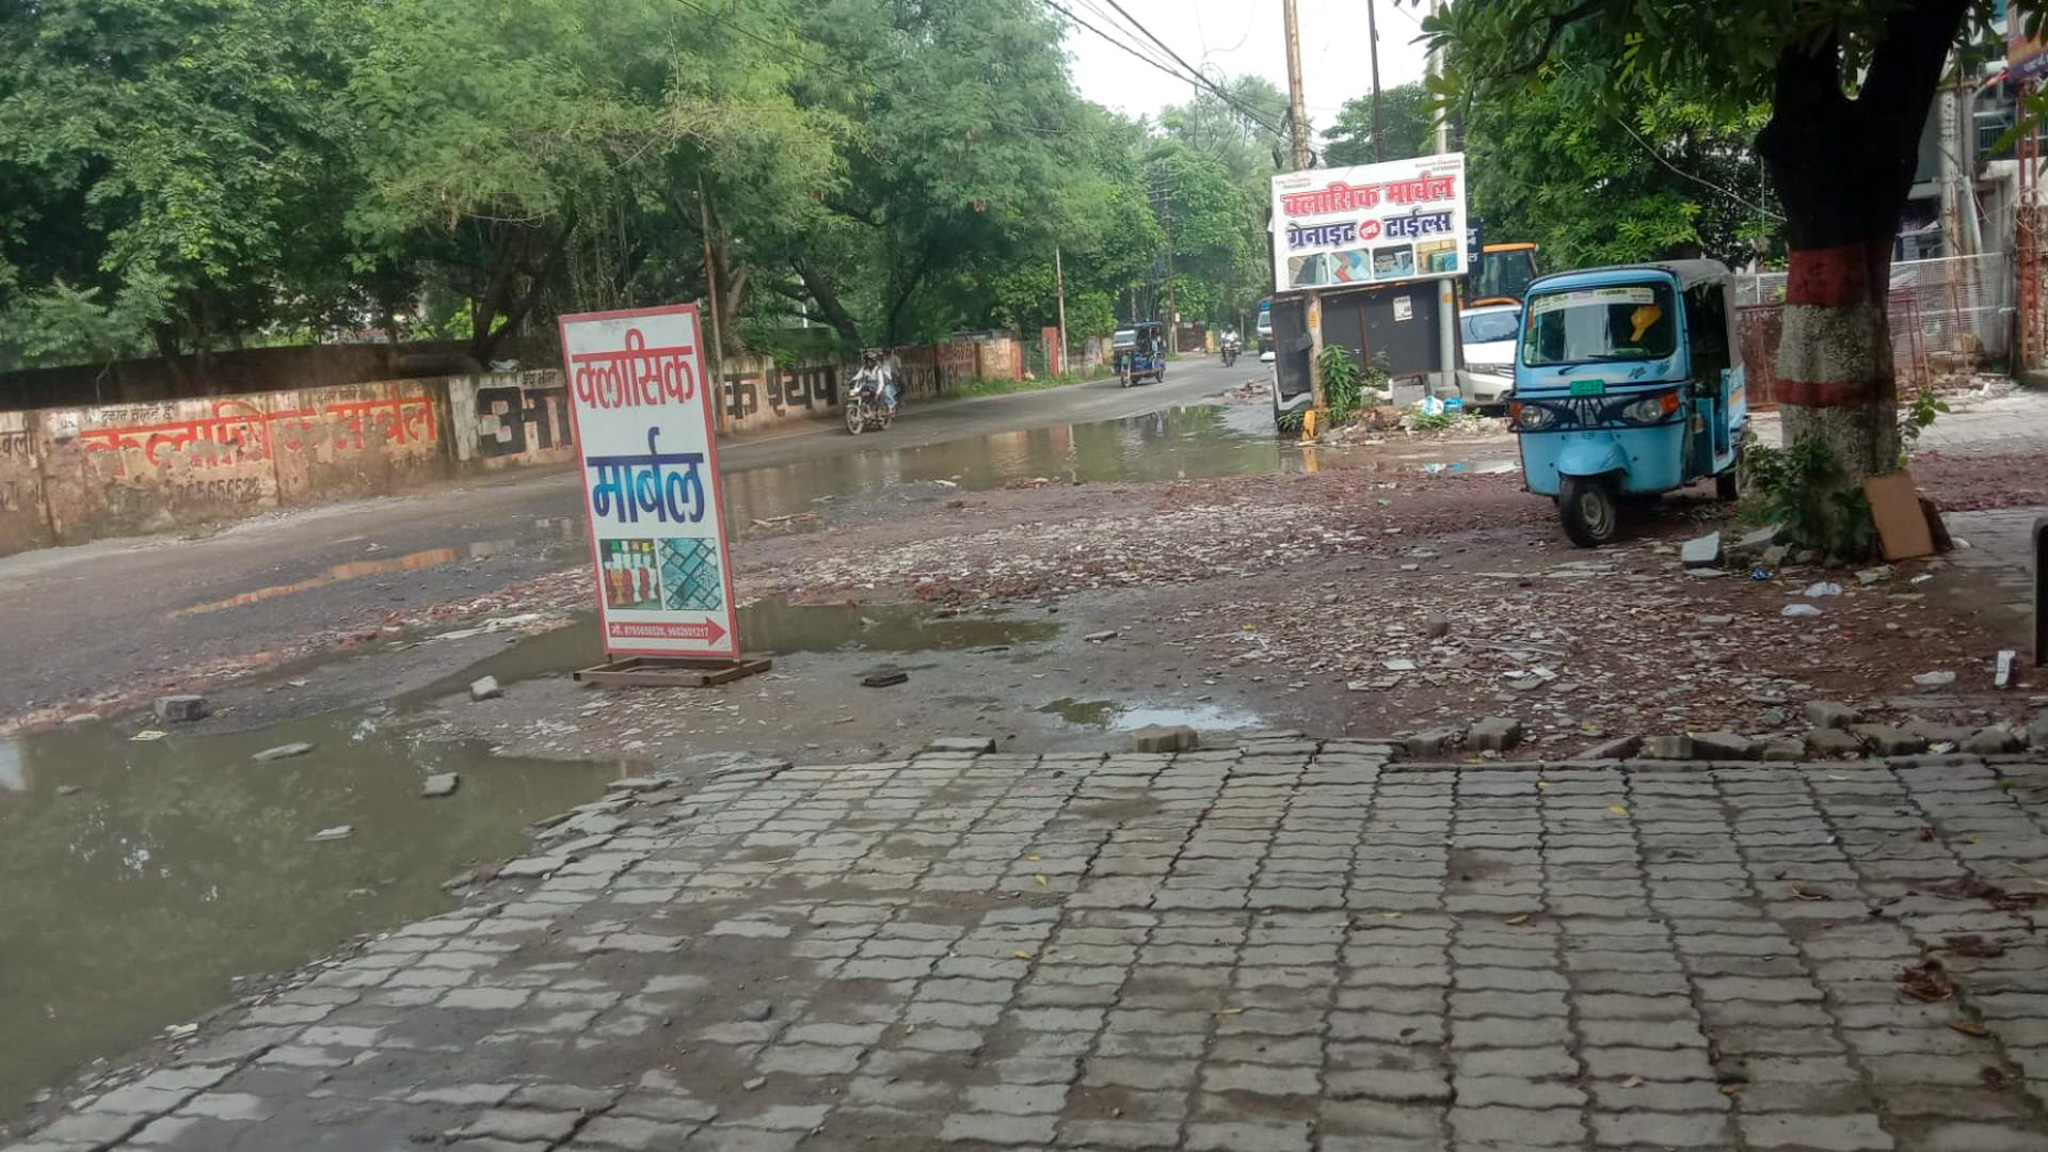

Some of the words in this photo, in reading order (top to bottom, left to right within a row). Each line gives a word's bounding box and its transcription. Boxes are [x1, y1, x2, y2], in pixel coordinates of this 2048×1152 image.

[1282, 182, 1380, 215] क्लासिक
[1384, 172, 1455, 203] मार्बल
[1287, 221, 1357, 247] ग्रेनाइट
[1383, 207, 1453, 238] टाईल्स
[572, 328, 694, 409] क्लासिक
[586, 427, 705, 524] मार्बल
